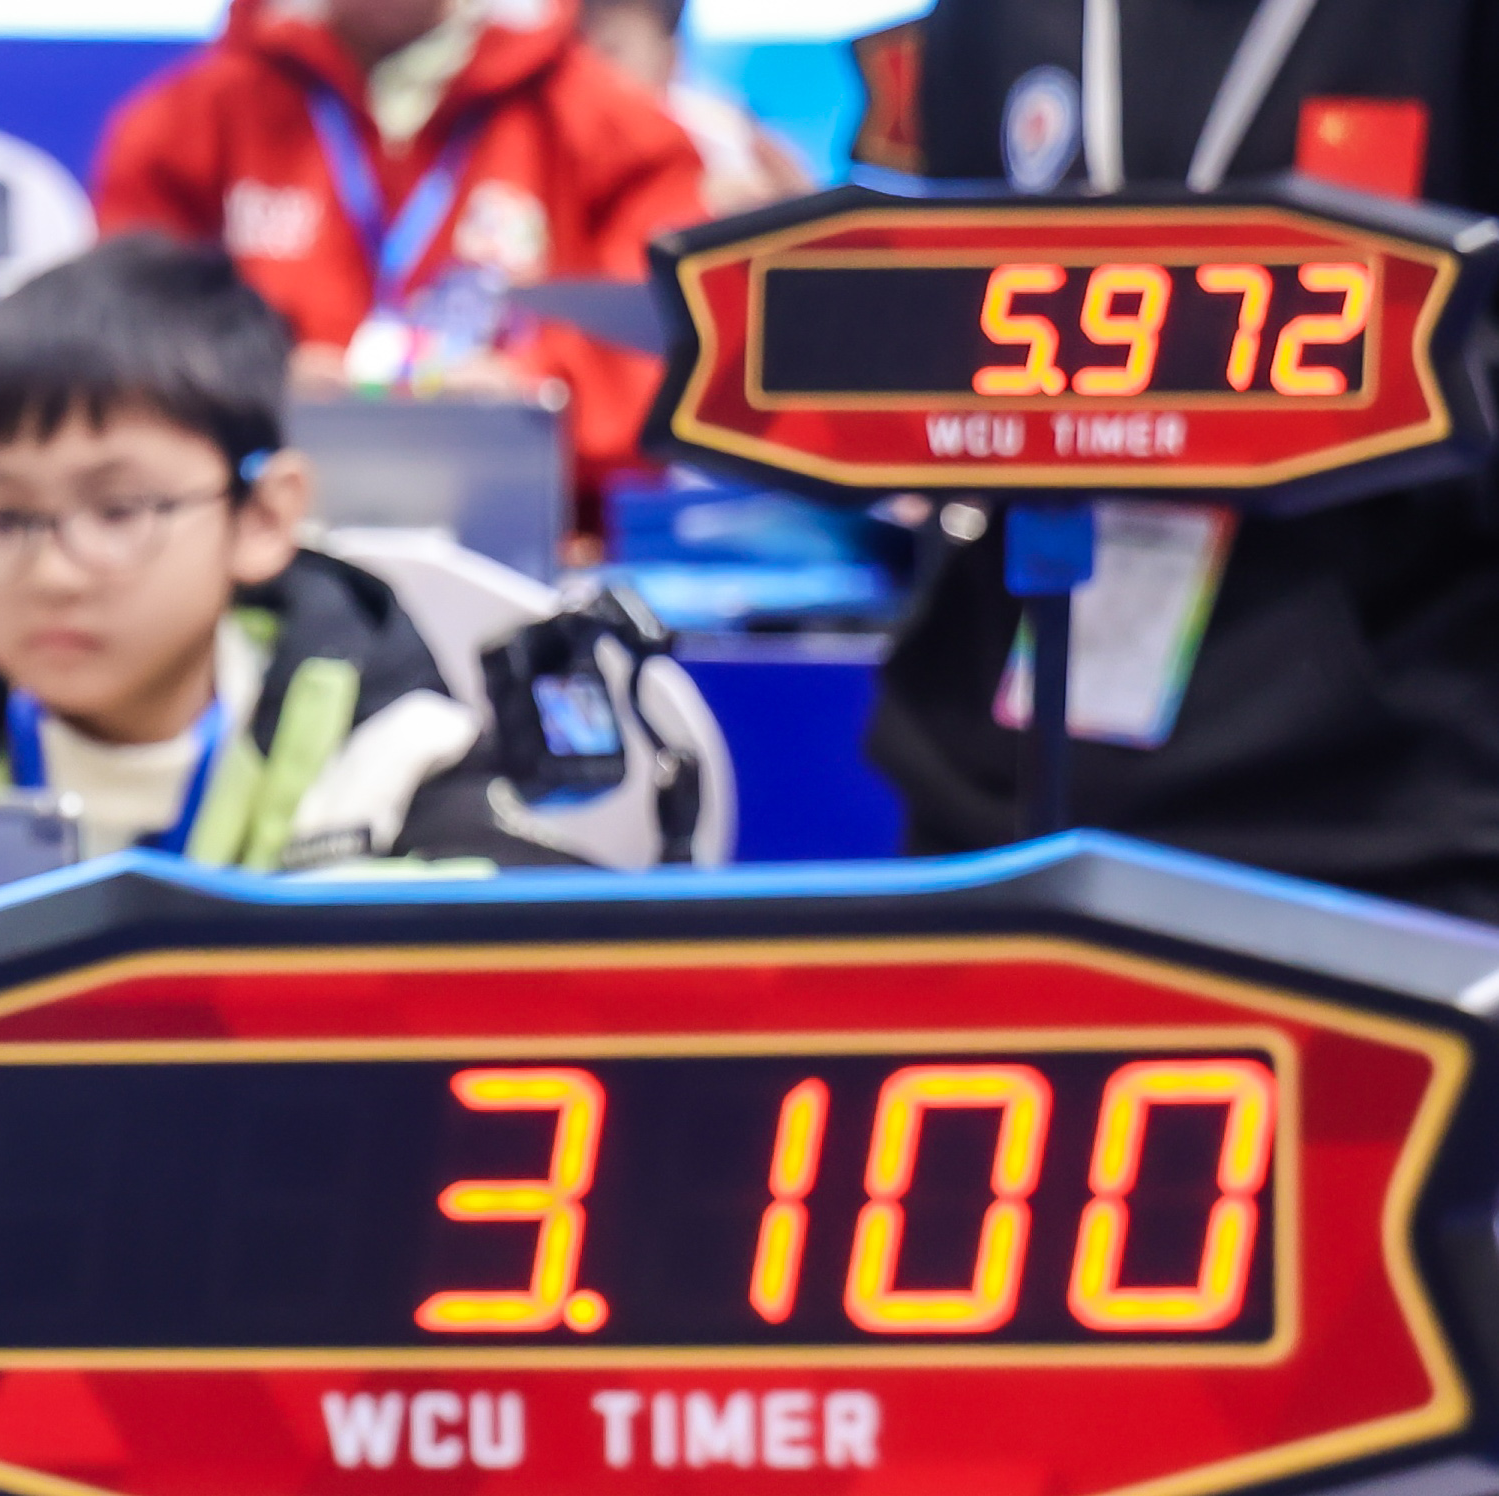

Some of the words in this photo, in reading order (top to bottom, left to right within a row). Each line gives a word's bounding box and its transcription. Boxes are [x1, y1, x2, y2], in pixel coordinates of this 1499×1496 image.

[972, 262, 1372, 396] 5.972
[926, 411, 1026, 458] WCU
[1052, 411, 1188, 458] TIMER
[414, 1060, 1278, 1333] 3.100
[321, 1390, 525, 1470] WCU
[591, 1390, 881, 1470] TIMER
